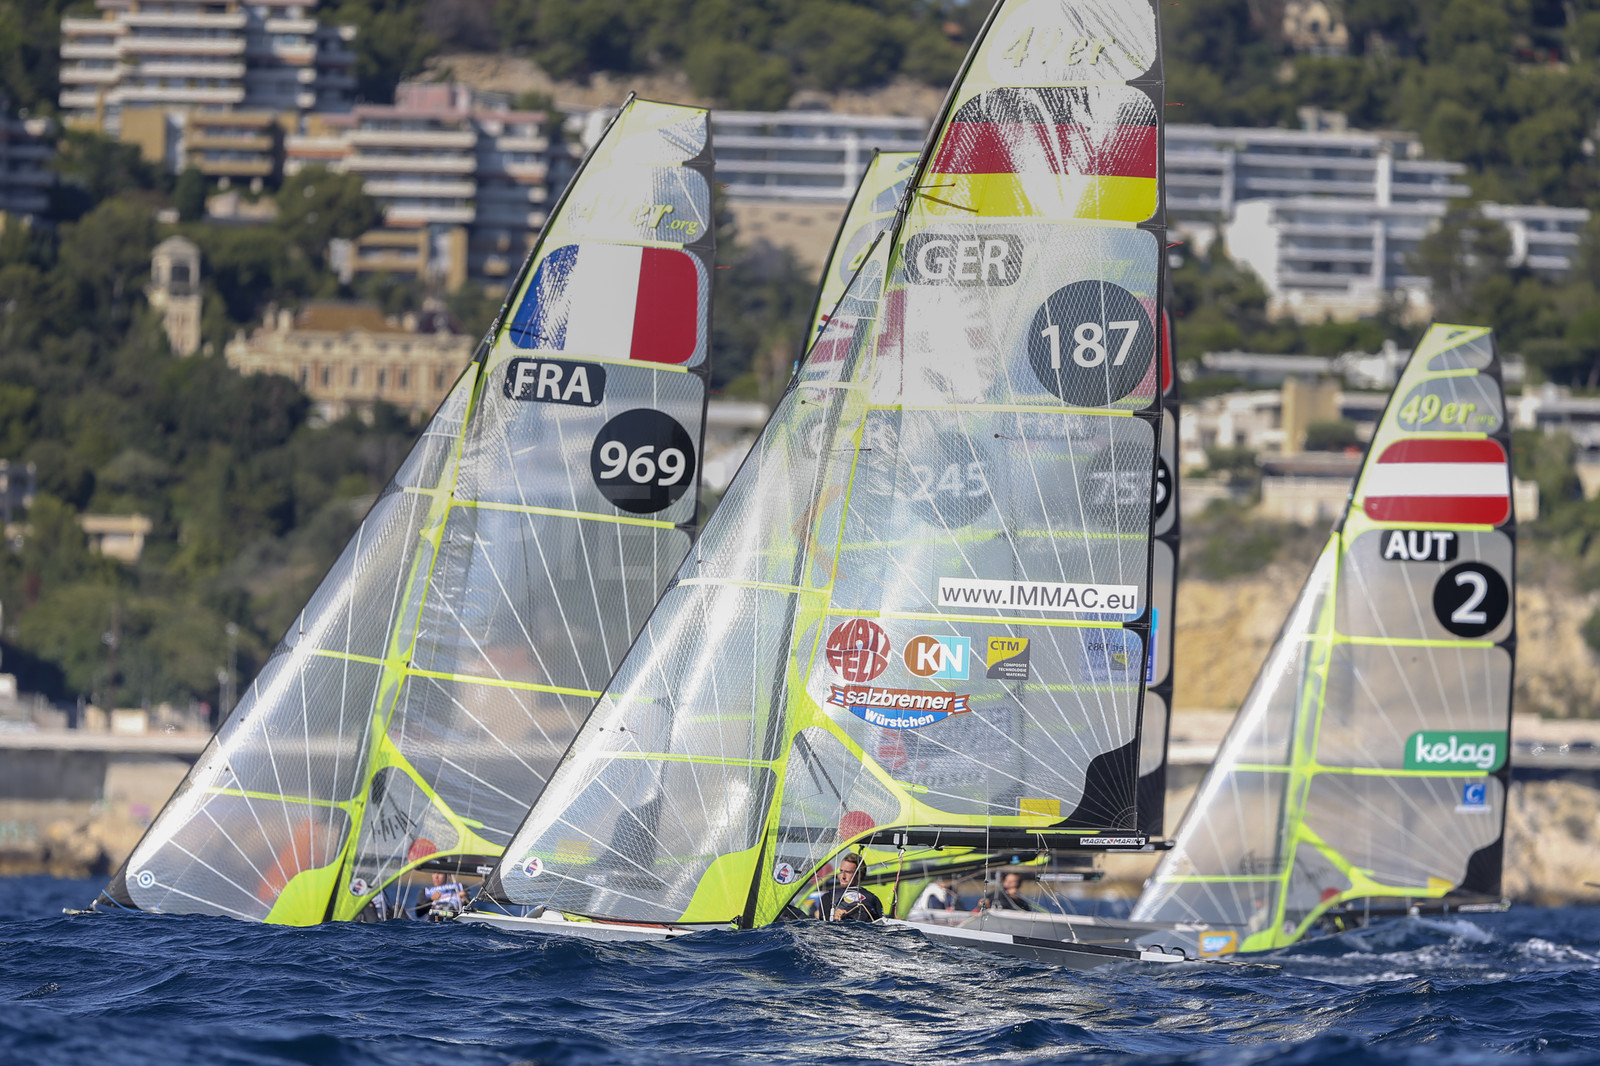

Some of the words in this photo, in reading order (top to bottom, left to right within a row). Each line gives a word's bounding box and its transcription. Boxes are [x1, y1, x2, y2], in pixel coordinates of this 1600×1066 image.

[916, 238, 1010, 282] GER
[1041, 320, 1140, 371] 187
[513, 361, 593, 404] FRA
[599, 440, 687, 487] 969
[1384, 531, 1455, 562] AUT
[942, 585, 1136, 610] www.IMMAC.eu
[1451, 571, 1488, 624] 2
[917, 642, 962, 673] KN
[990, 640, 1019, 651] CTM
[846, 688, 953, 711] salzbrenner
[864, 709, 935, 728] Würstchen
[1415, 733, 1496, 769] kelag
